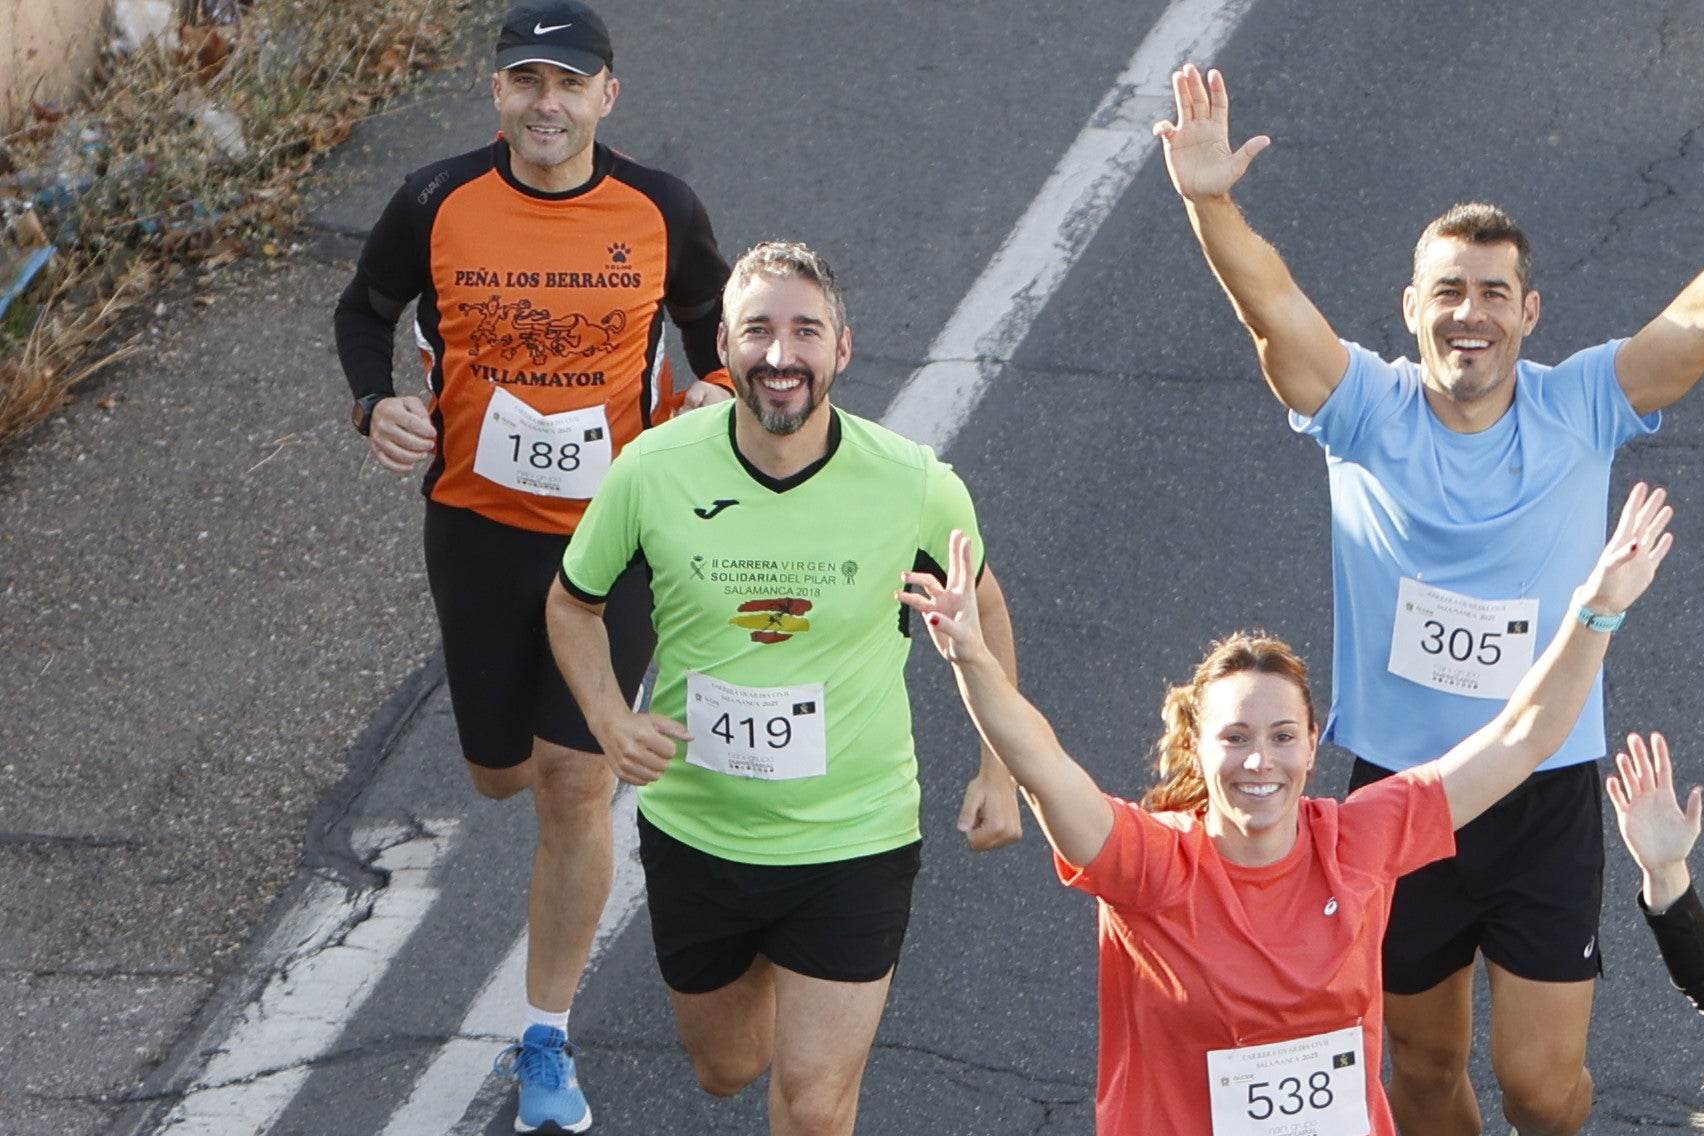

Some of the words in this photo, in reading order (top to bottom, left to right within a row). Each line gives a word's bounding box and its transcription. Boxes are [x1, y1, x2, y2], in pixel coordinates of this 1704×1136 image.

[454, 267, 500, 288] PEÑA
[505, 271, 540, 288] LOS
[544, 271, 642, 289] BERRACOS
[469, 363, 606, 388] VILLAMAYOR
[508, 434, 581, 472] 188
[711, 559, 719, 569] II
[721, 559, 778, 570] CARRERA
[780, 560, 837, 572] VIRGEN
[710, 572, 778, 583] SOLIDARIA
[779, 573, 800, 584] DEL
[803, 574, 837, 585] PILAR
[724, 585, 794, 596] SALAMANCA
[796, 586, 822, 598] 2018
[1420, 619, 1503, 667] 305
[711, 712, 792, 749] 419
[1247, 1070, 1334, 1121] 538
